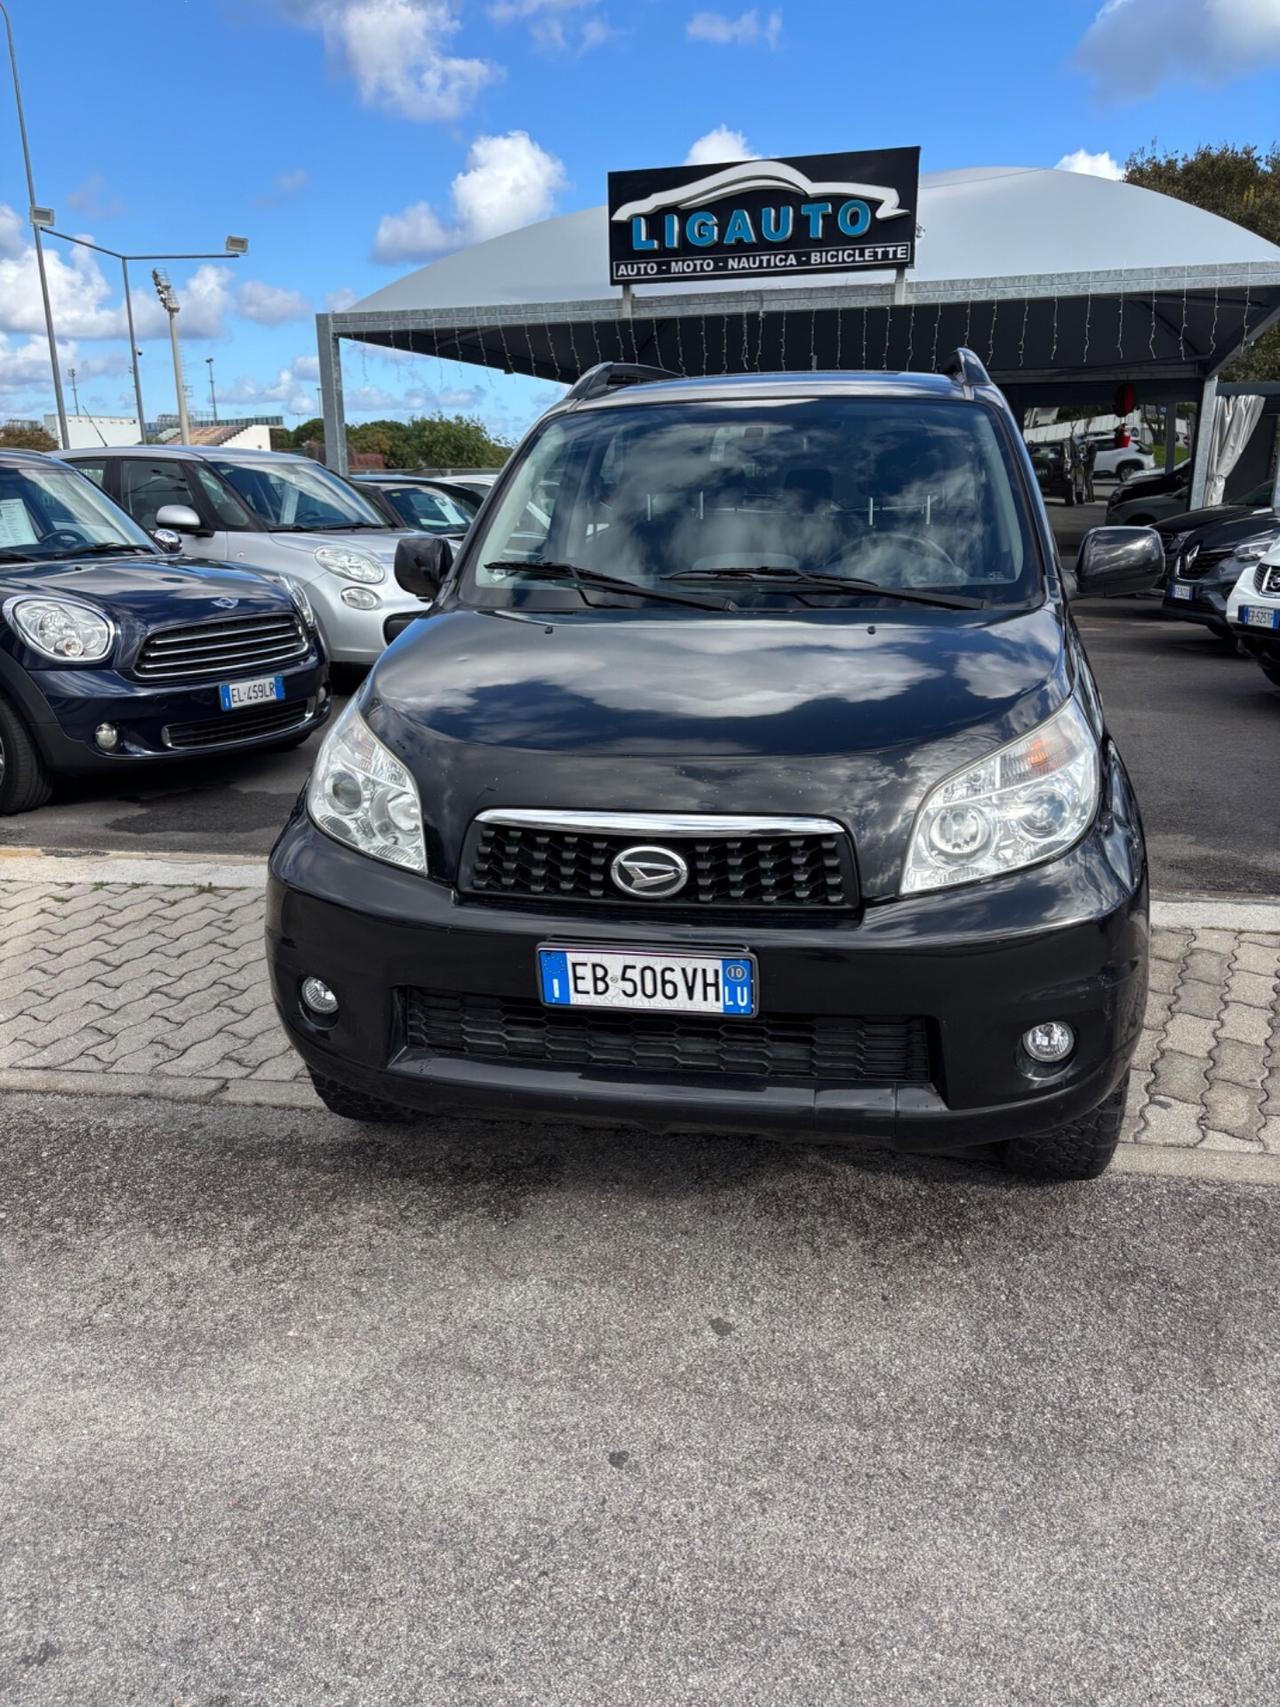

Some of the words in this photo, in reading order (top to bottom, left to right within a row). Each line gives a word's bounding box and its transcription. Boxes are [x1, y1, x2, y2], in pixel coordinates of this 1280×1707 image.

[631, 199, 872, 250] LIGAUTO
[617, 263, 657, 276] AUTO
[670, 259, 714, 273] MOTO
[728, 253, 797, 270] NAUTICA
[810, 246, 907, 264] BICICLETTE
[571, 962, 609, 996] EB
[620, 964, 720, 1002] 506VH
[724, 985, 747, 1006] LU
